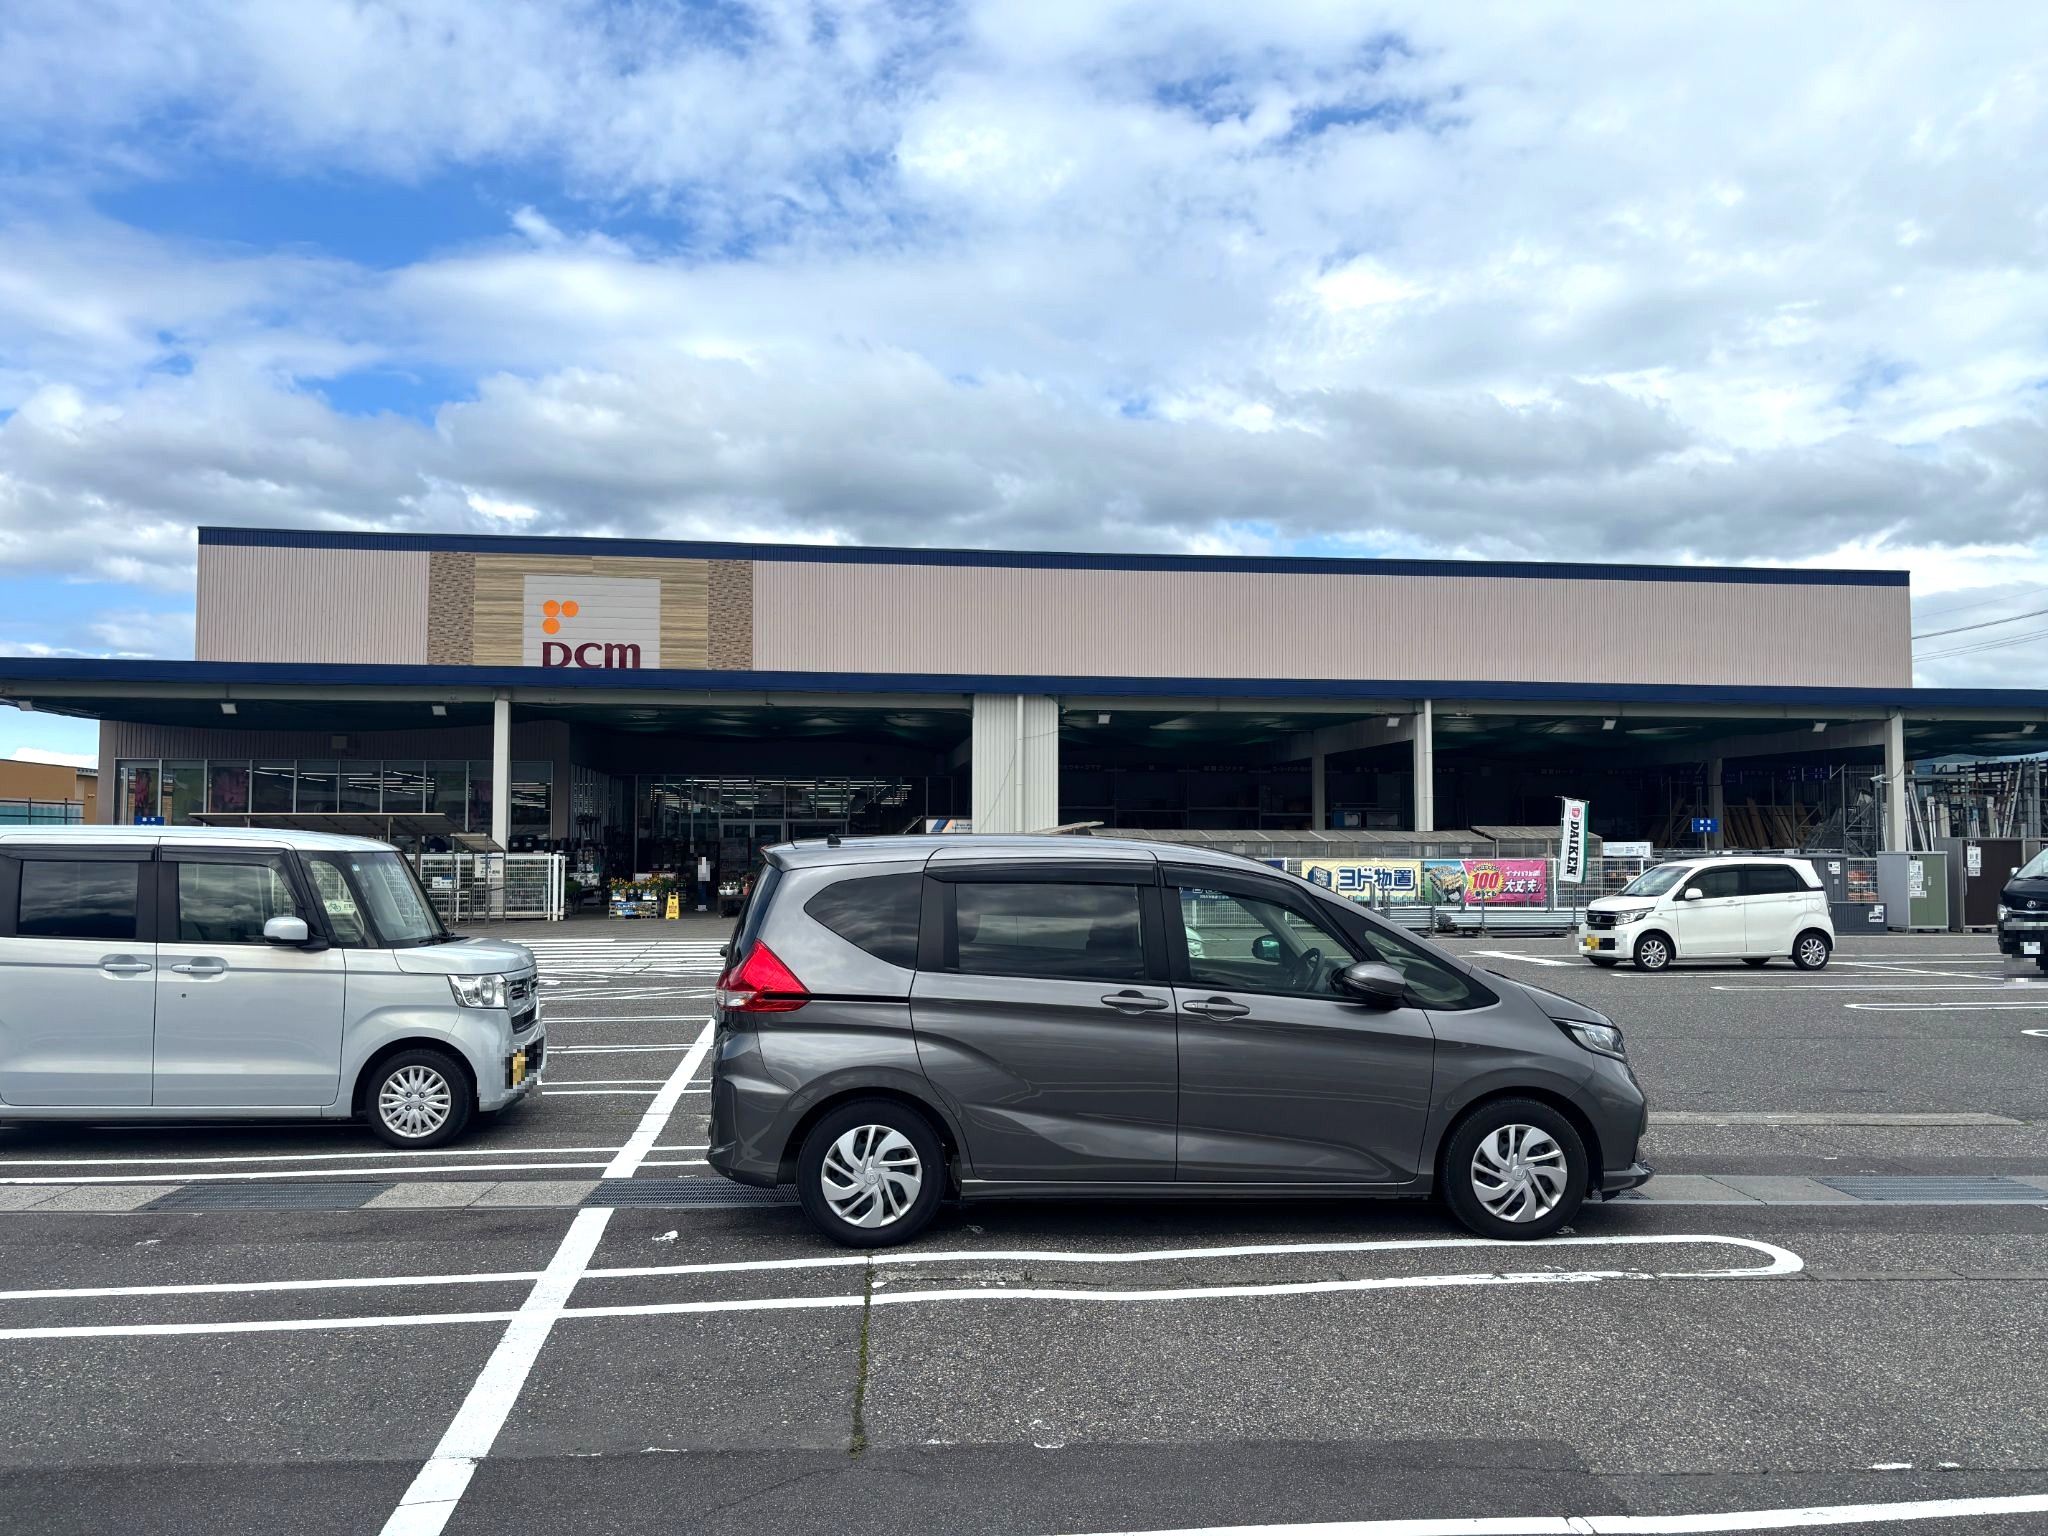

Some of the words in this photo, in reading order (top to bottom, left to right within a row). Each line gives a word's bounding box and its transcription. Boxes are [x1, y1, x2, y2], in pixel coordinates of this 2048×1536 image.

[1566, 820, 1579, 875] DAIKEN
[1338, 867, 1413, 888] ヨド物置
[1472, 872, 1500, 889] 100
